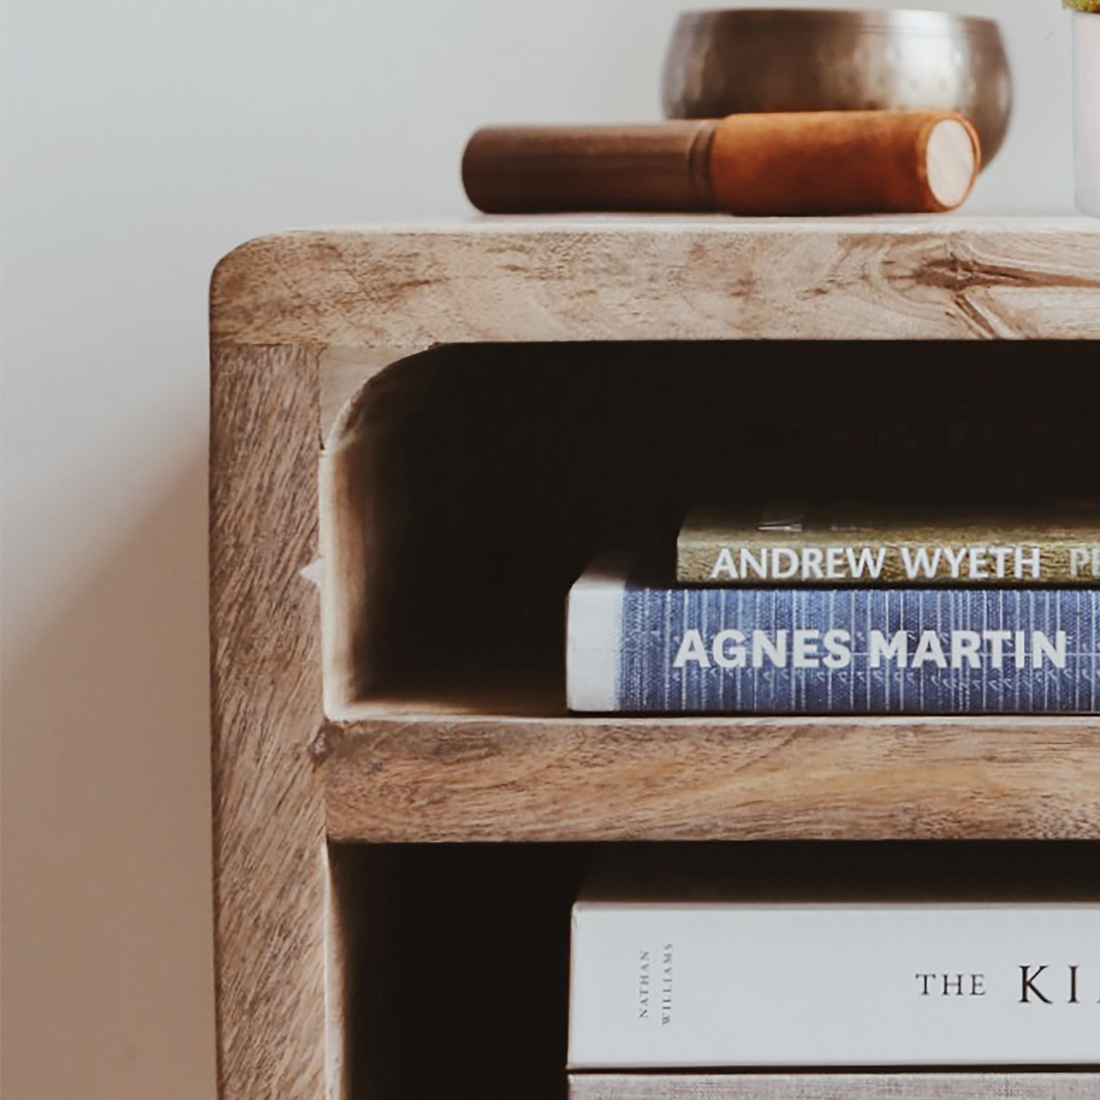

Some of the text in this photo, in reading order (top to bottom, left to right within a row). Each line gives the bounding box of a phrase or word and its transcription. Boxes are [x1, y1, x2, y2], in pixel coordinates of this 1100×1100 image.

[710, 546, 886, 580] ANDREW
[900, 547, 1041, 580] WYETH
[673, 629, 1068, 670] AGNES MARTIN
[639, 949, 650, 1019] NATHAN
[661, 943, 673, 1026] WILLIAMS
[915, 973, 987, 996] THE
